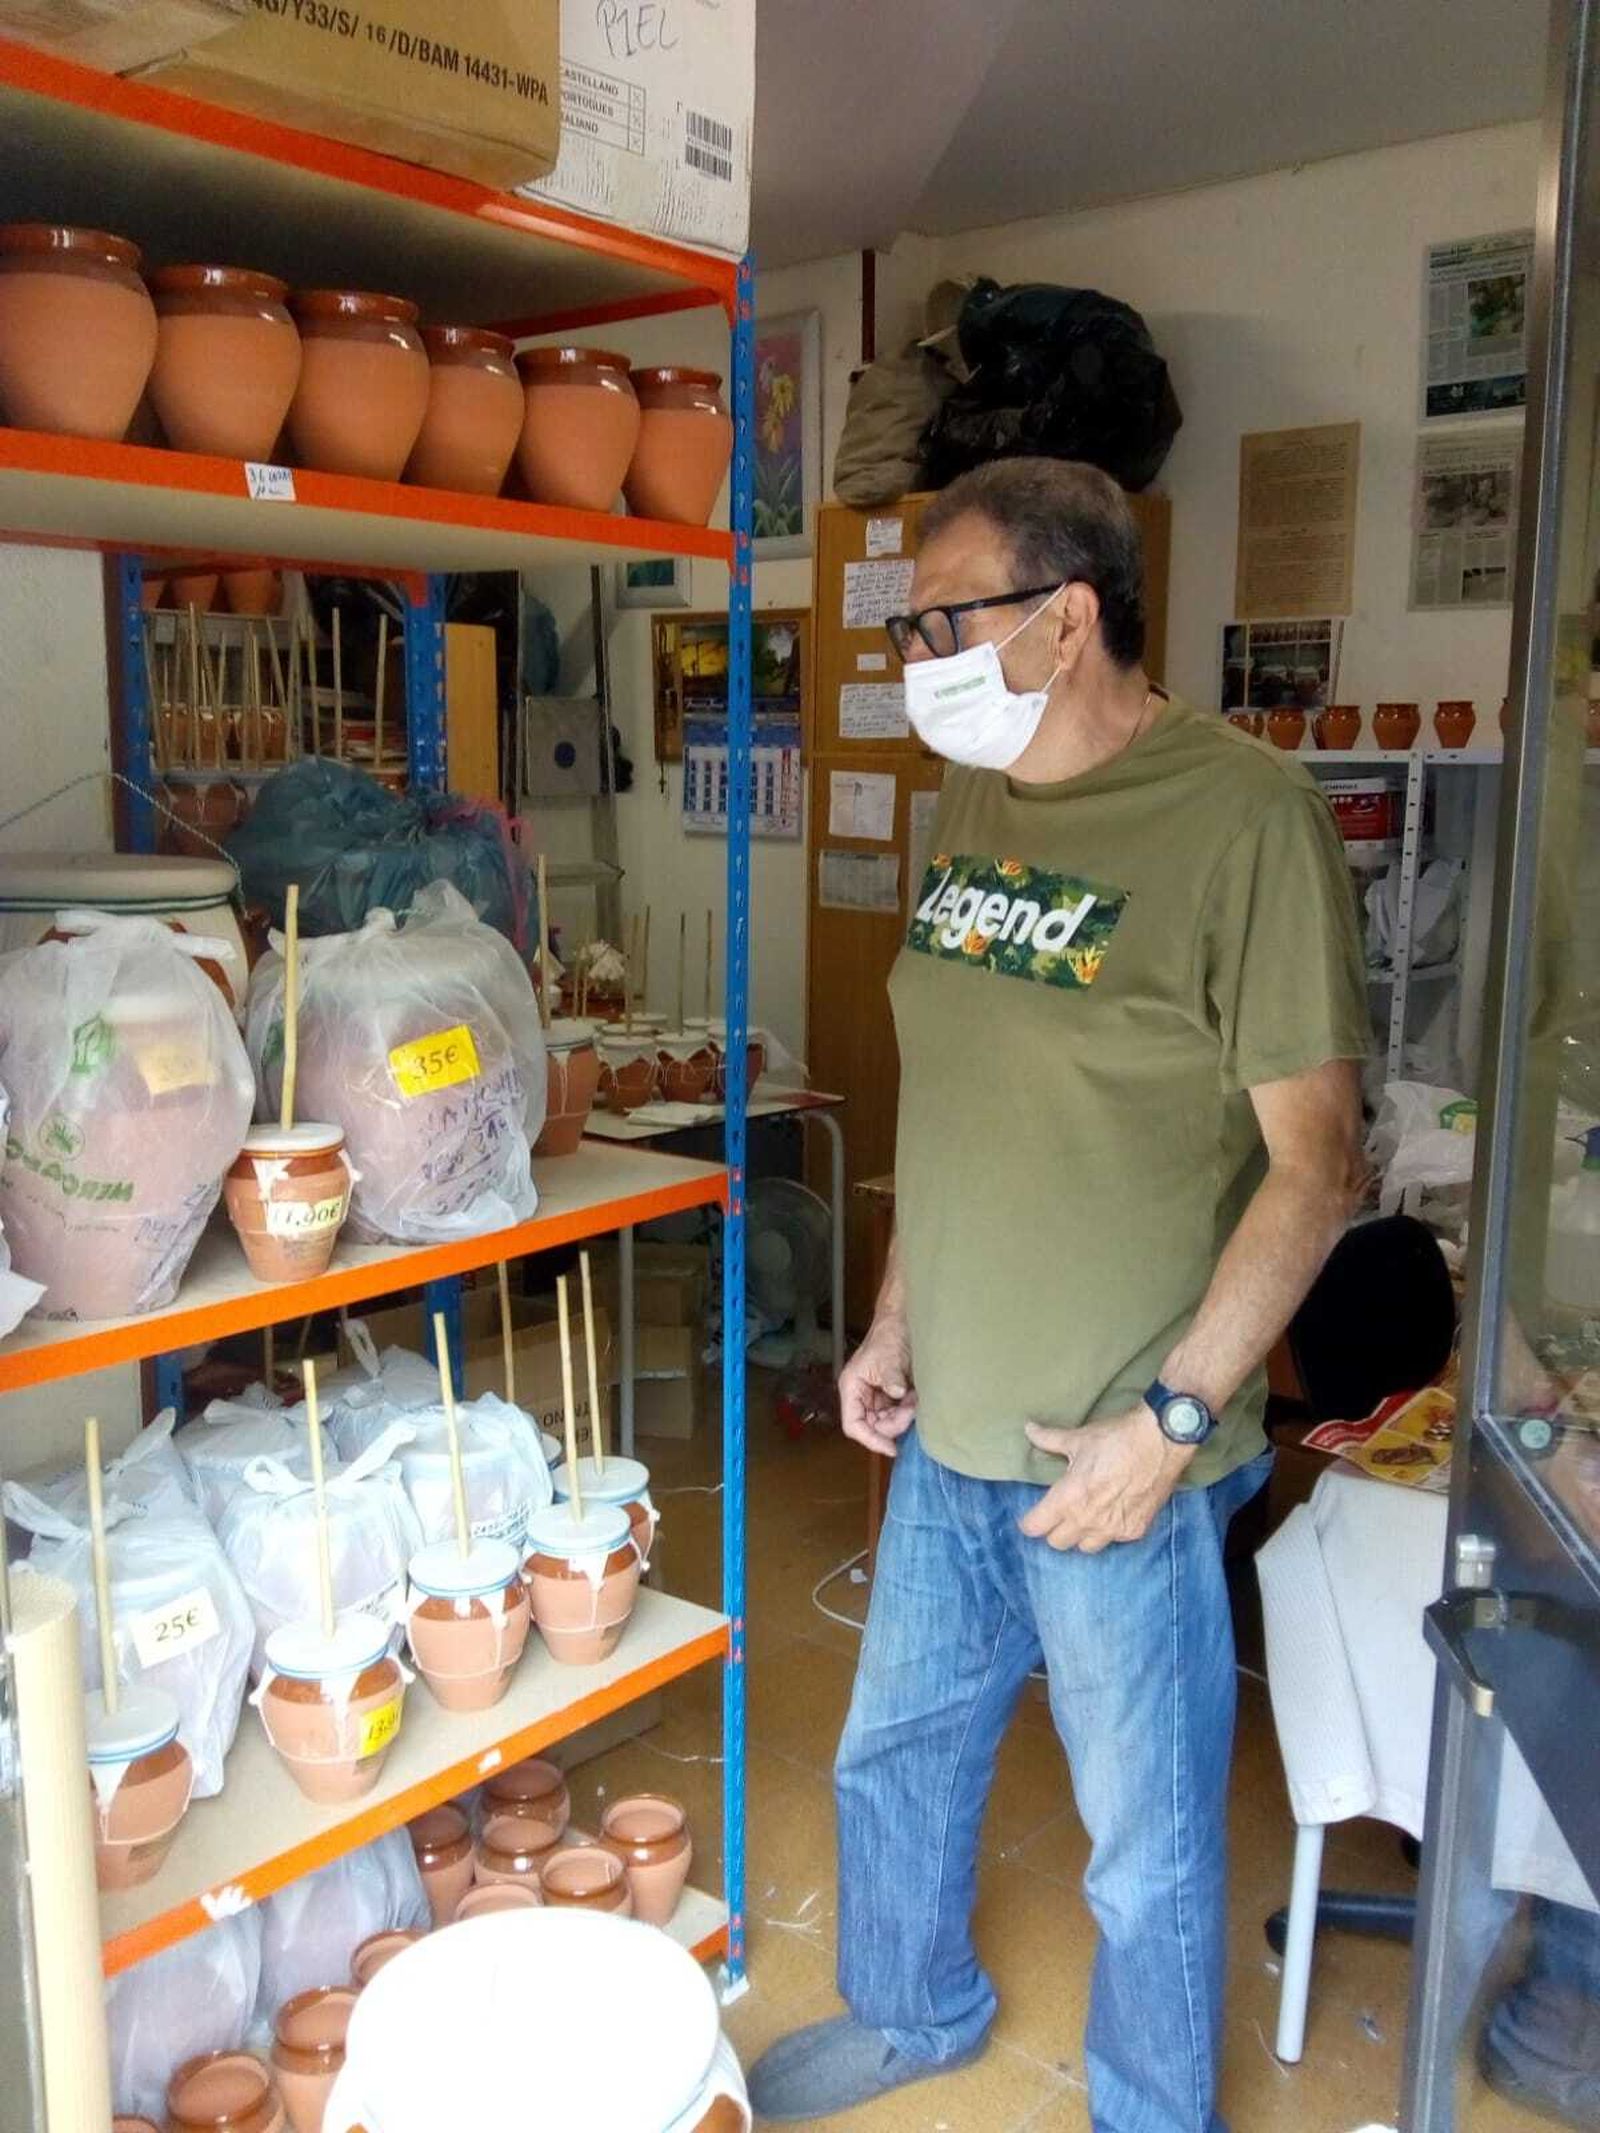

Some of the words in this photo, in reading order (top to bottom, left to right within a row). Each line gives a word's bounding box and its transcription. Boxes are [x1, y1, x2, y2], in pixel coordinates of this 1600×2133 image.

[464, 53, 549, 106] 14431-WPA
[561, 65, 619, 97] ASTELLANO
[561, 91, 614, 118] ORTUGUES
[560, 113, 599, 135] ALIANO
[915, 866, 1097, 953] Legend
[411, 1043, 461, 1080] 35€
[154, 1605, 200, 1642] 25€
